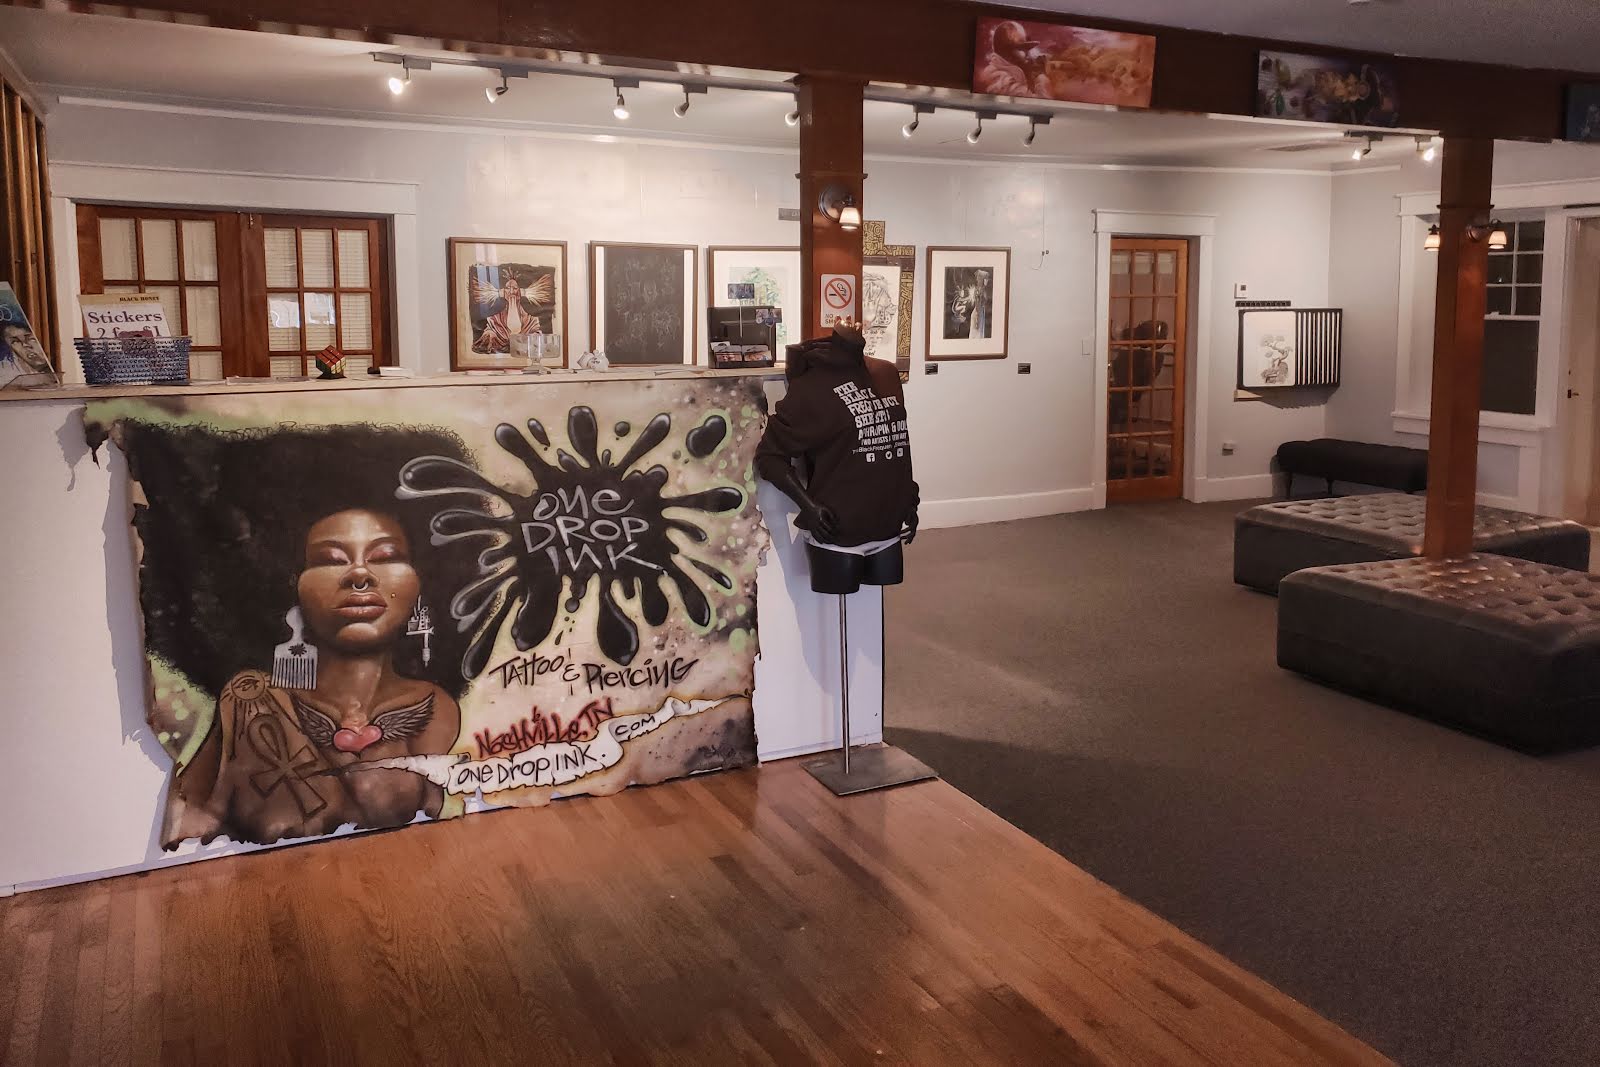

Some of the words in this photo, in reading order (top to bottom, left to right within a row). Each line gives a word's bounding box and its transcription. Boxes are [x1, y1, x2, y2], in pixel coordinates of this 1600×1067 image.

[87, 311, 163, 324] Stickers
[96, 327, 106, 339] 2
[833, 381, 859, 397] THE
[840, 387, 877, 406] BLACK
[520, 515, 650, 553] DROP
[545, 542, 669, 577] INK
